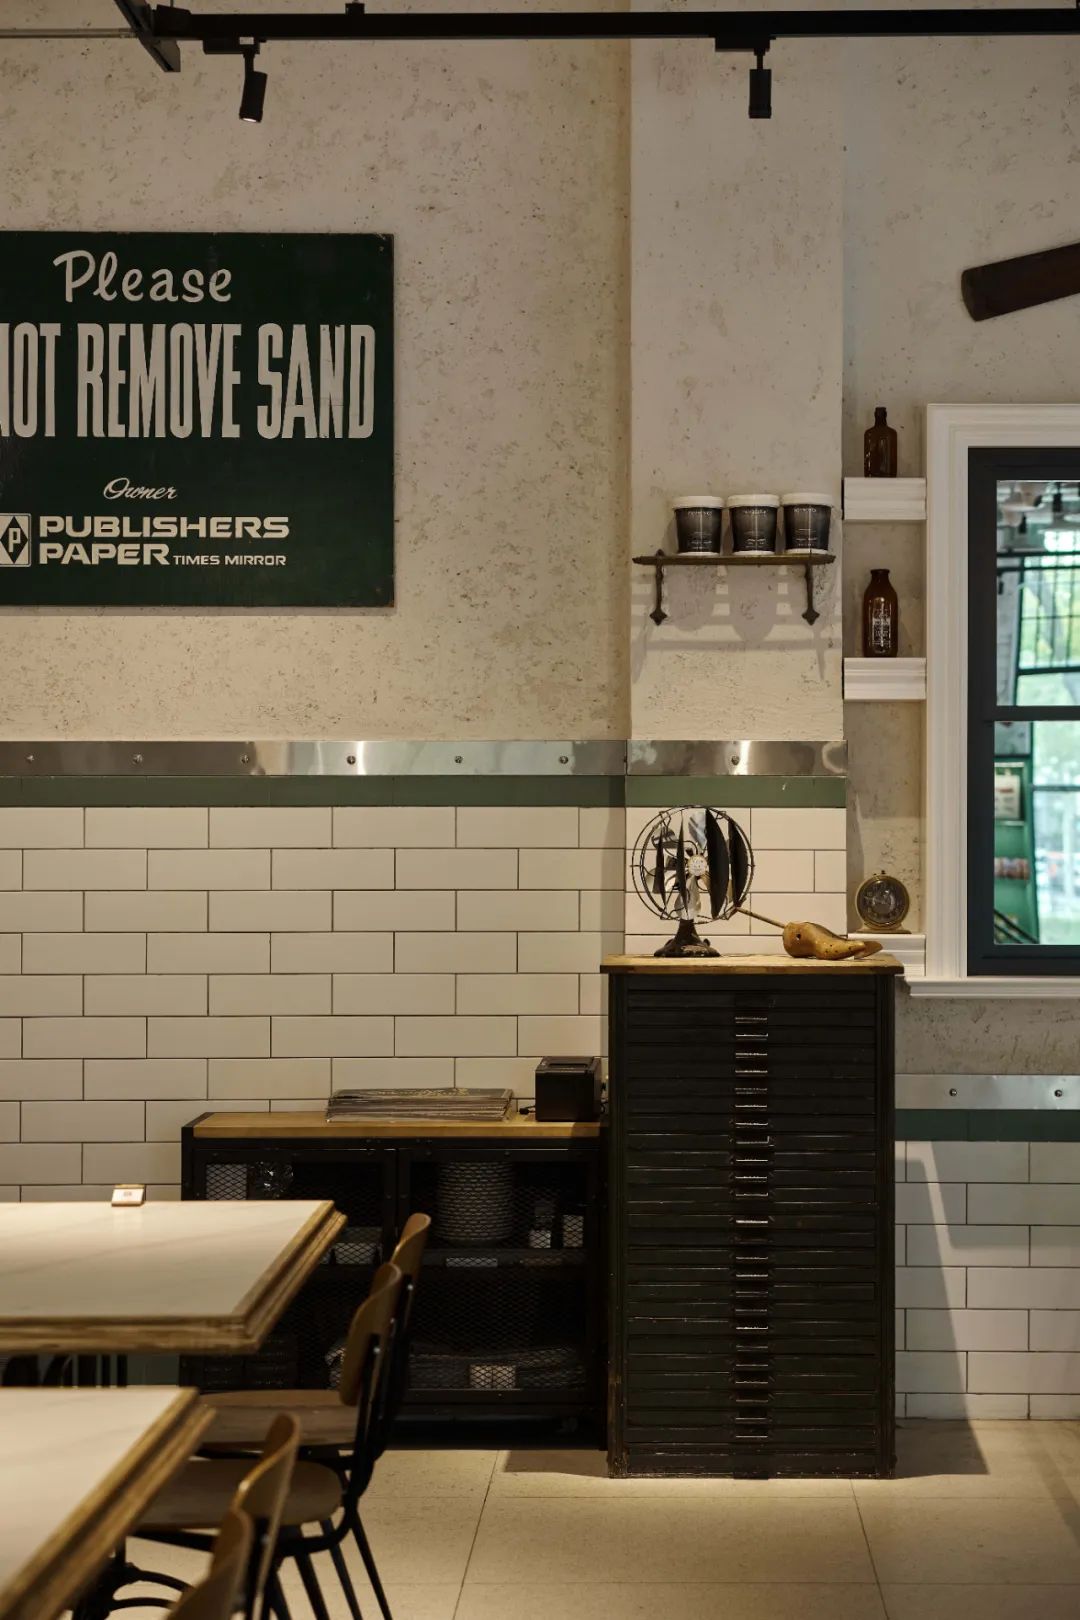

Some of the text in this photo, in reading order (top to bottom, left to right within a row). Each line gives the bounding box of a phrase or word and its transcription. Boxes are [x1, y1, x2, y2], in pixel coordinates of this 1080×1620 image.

[53, 250, 232, 303] Please
[77, 322, 242, 438] REMOVE
[257, 323, 376, 439] SAND
[103, 477, 178, 500] Owner
[39, 515, 290, 539] PUBLISHERS
[39, 542, 287, 566] PAPER TIMES MIRROR
